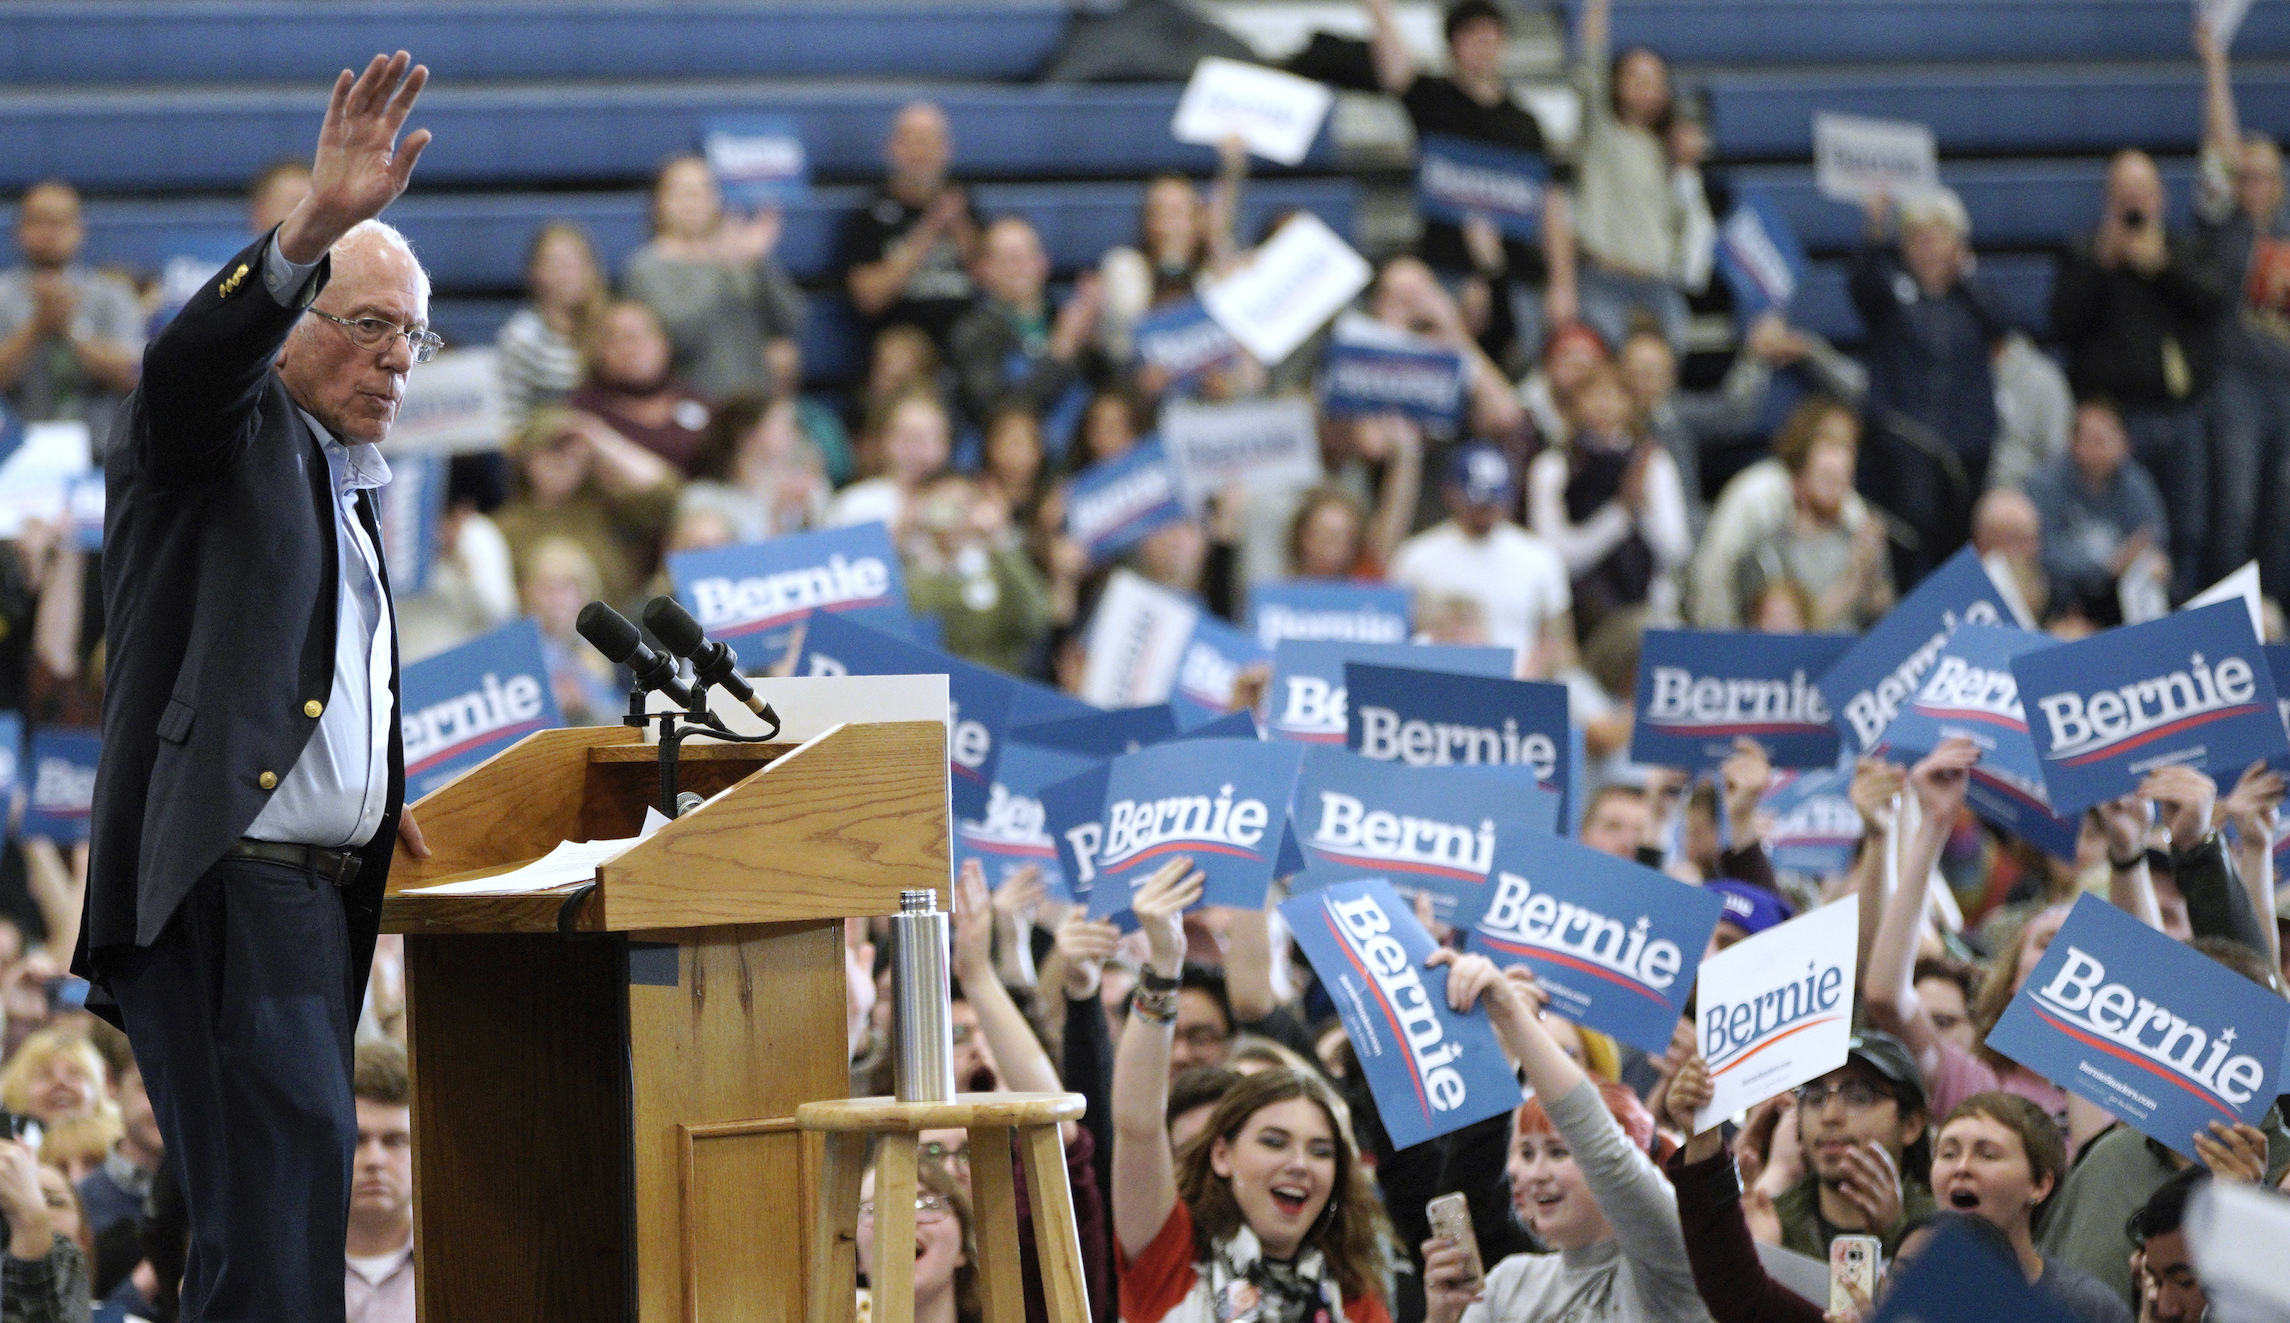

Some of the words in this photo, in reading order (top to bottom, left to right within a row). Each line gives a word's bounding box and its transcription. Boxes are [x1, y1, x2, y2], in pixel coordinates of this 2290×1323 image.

[690, 553, 889, 626] Bernie
[402, 672, 543, 760] ernie
[1358, 705, 1557, 780] Bernie
[2038, 652, 2256, 752] Bernie
[1103, 780, 1269, 858] Bernie
[1313, 788, 1497, 876] Berni
[1482, 871, 1683, 990] Bernie
[1334, 892, 1467, 1113] Bernie
[1705, 959, 1843, 1061] Bernie
[2040, 945, 2265, 1105] Bernie
[2078, 1060, 2158, 1112] BernieSanders.com
